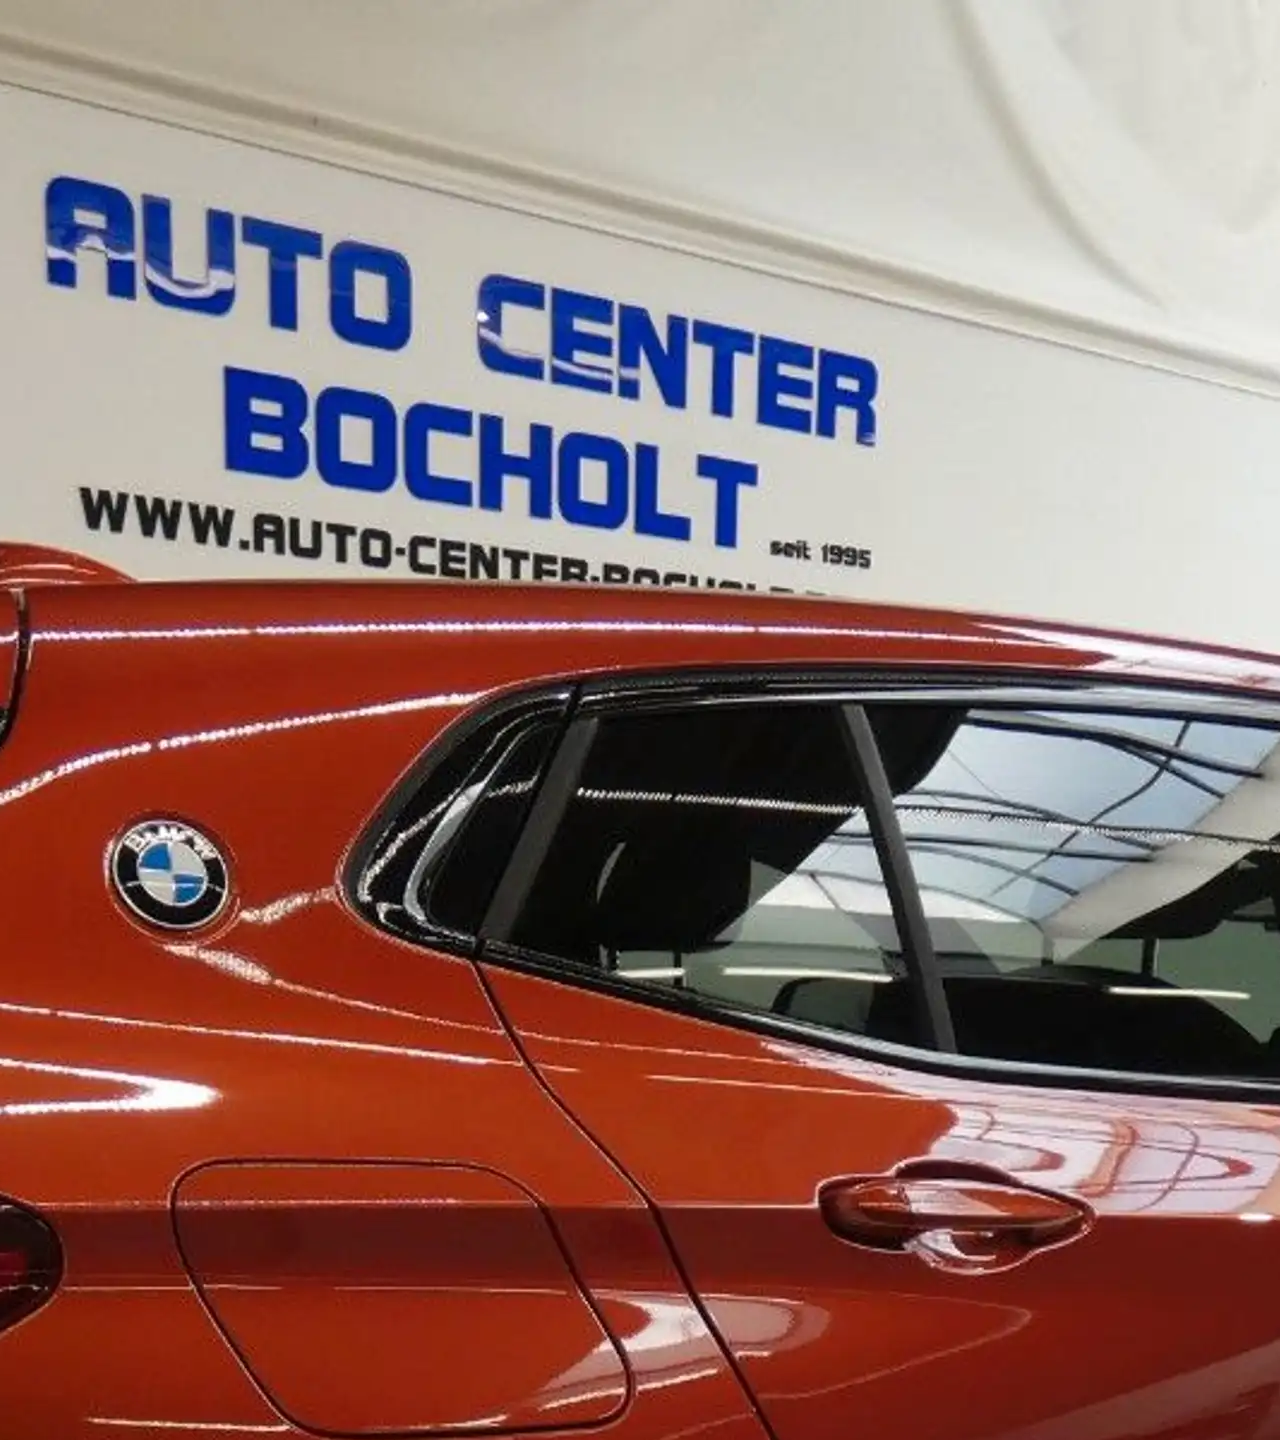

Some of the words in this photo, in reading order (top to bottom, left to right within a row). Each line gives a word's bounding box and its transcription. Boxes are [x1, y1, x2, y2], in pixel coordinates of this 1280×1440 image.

[45, 176, 413, 352] AUTO
[477, 273, 878, 446] CENTER
[224, 366, 759, 550] BOCHOLT
[770, 540, 811, 561] seit
[821, 544, 872, 569] 1995
